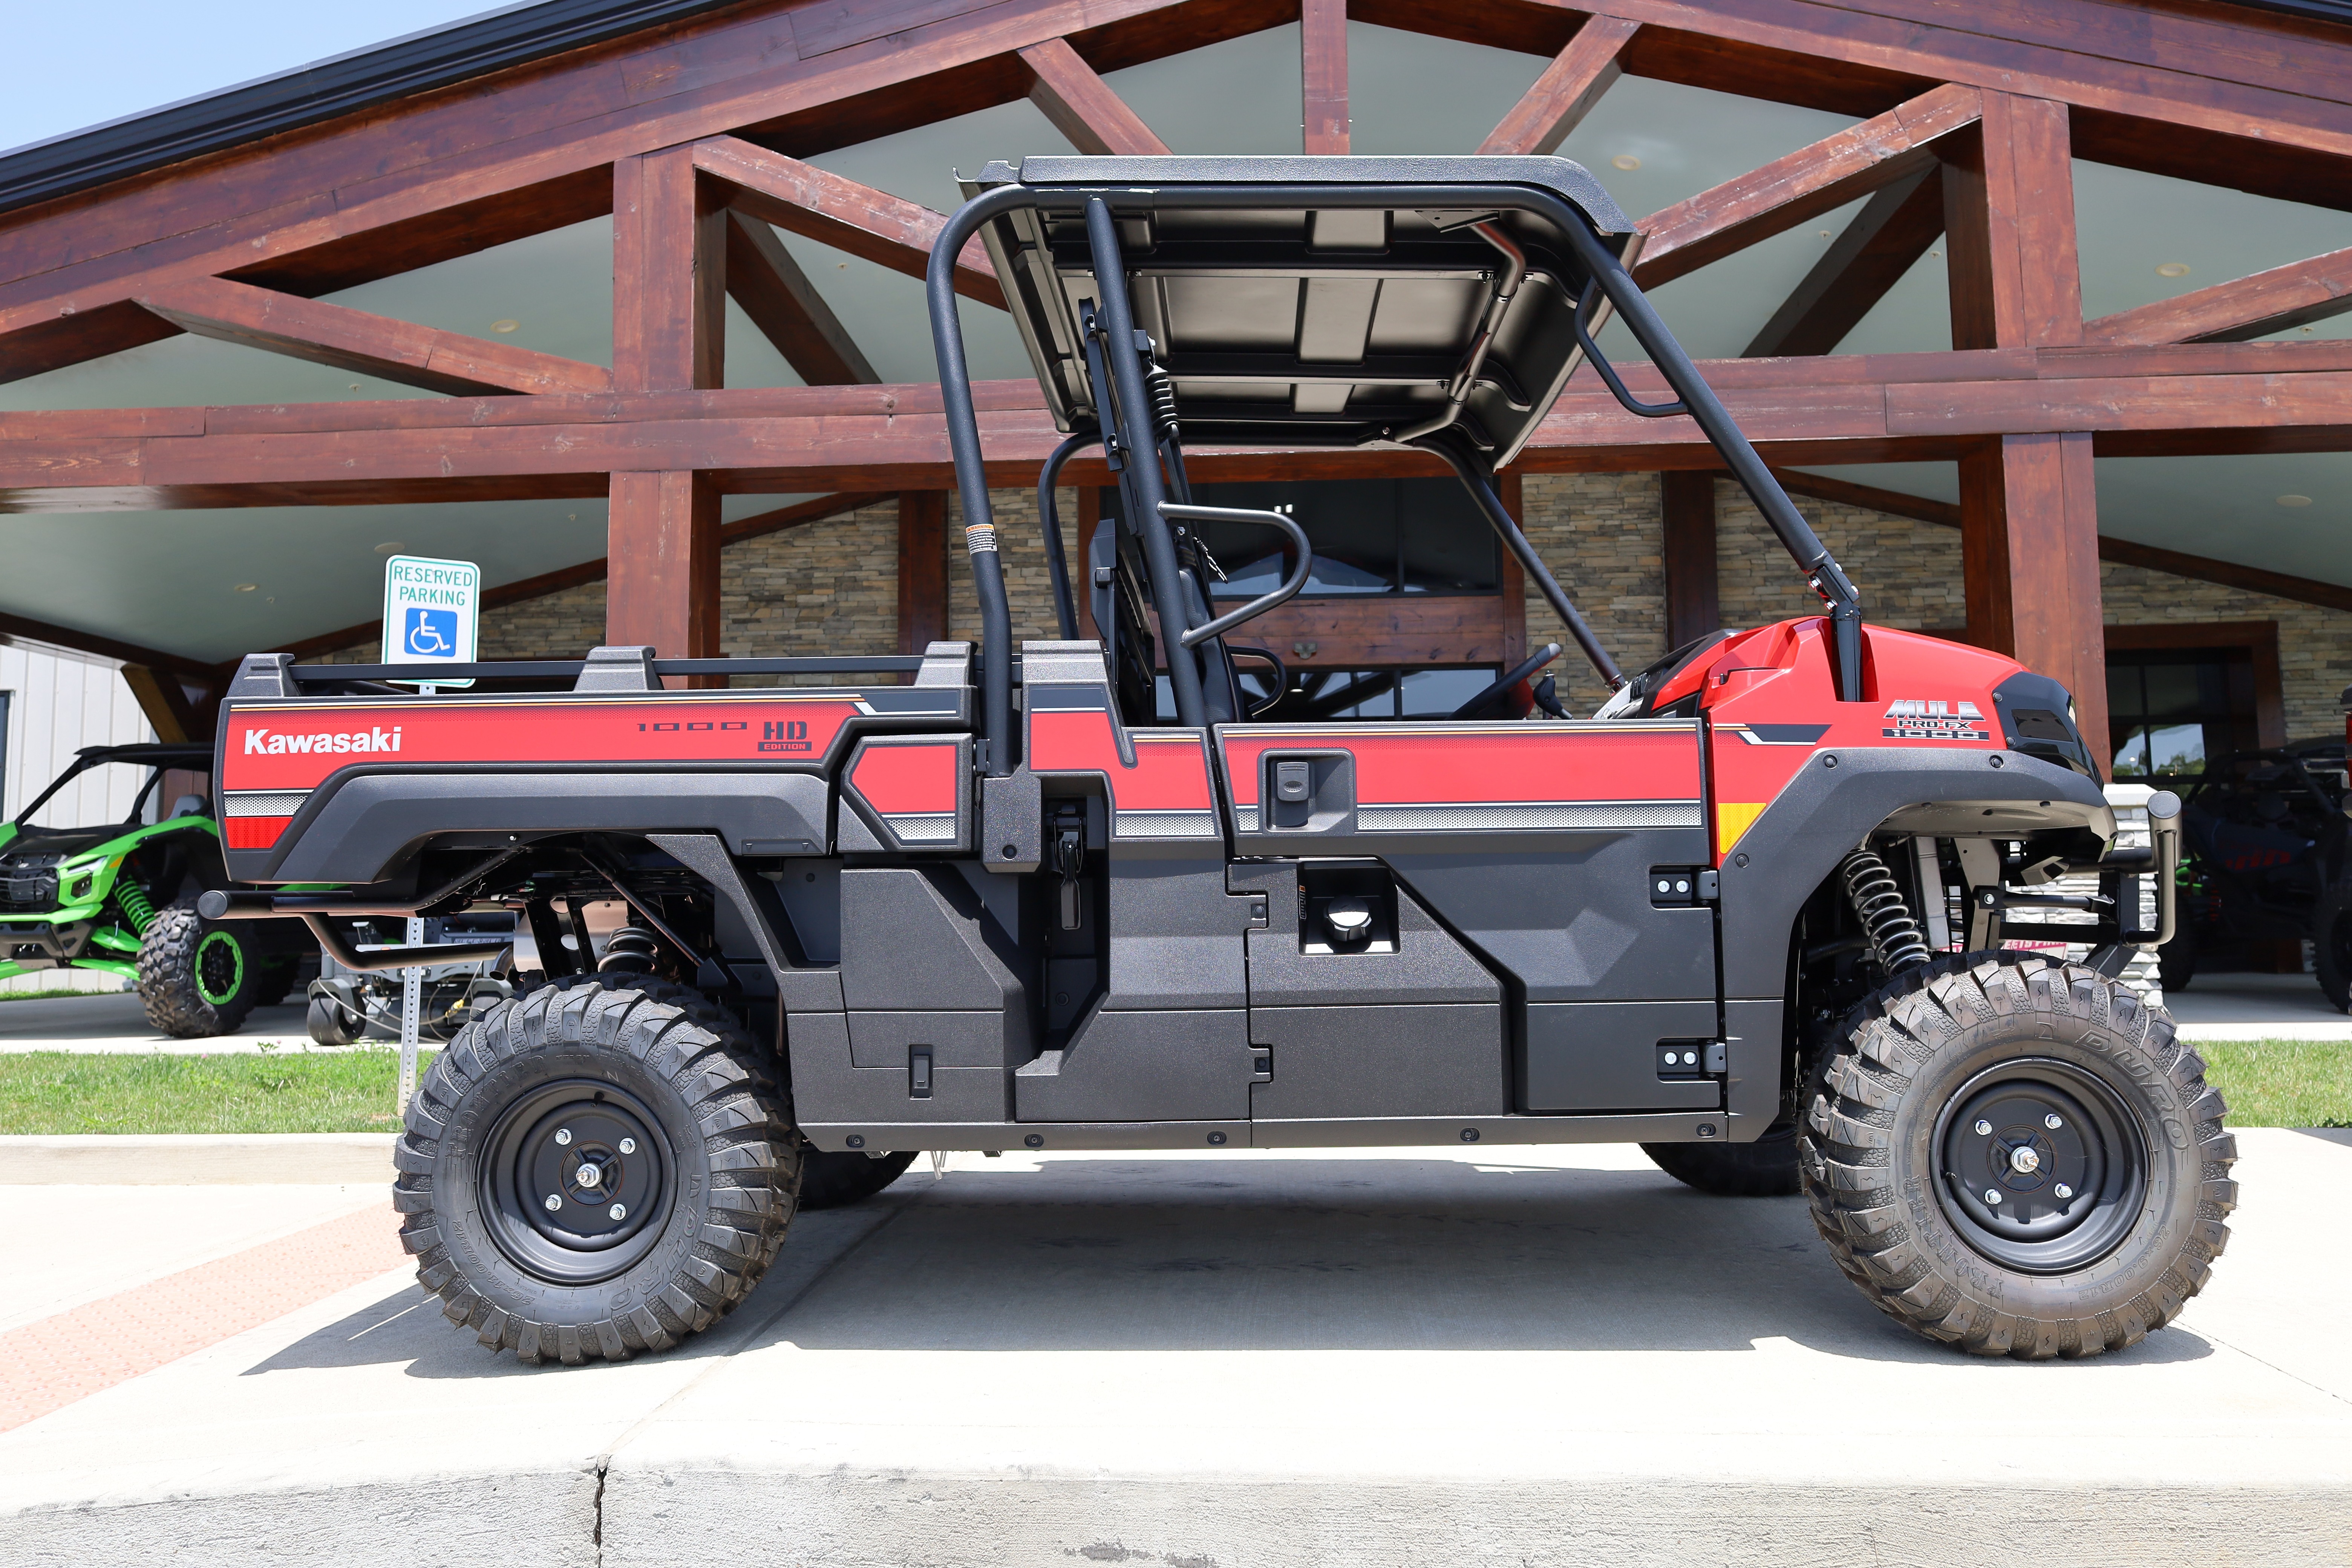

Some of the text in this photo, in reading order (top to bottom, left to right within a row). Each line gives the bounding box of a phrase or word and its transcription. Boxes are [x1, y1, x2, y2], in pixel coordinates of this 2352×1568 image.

[394, 565, 472, 586] RESERVED
[400, 586, 465, 606] PARKING
[1883, 699, 1986, 721] MULE
[637, 722, 747, 732] 1000
[763, 721, 807, 740] HD
[1891, 729, 1979, 739] 1000
[1896, 719, 1973, 730] PRO-FX
[244, 726, 402, 755] Kawasaki
[2075, 1029, 2190, 1150] DURO
[446, 1054, 547, 1160] FRONTIER
[1904, 1174, 2005, 1299] FRONTIER
[608, 1206, 700, 1311] DURO
